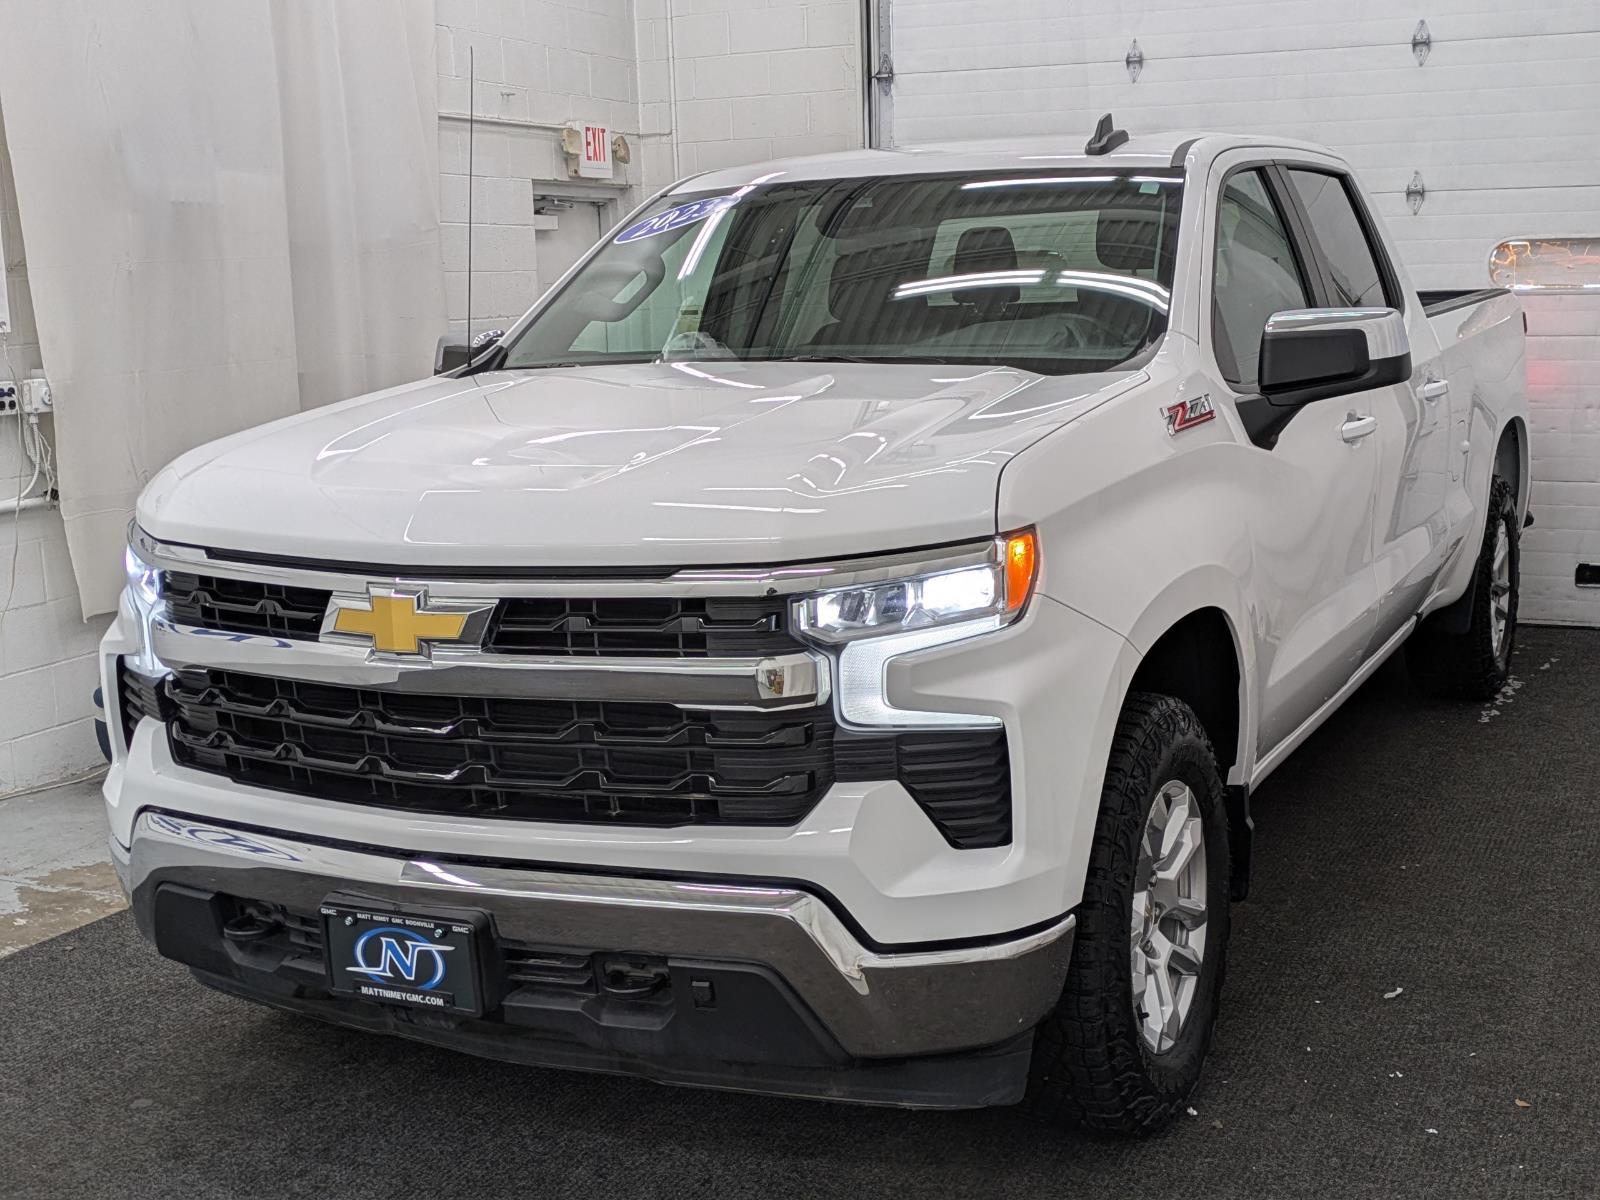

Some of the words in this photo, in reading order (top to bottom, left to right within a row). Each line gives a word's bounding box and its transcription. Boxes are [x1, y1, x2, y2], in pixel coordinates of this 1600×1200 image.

[585, 127, 606, 162] EXIT
[1160, 393, 1216, 436] Z71
[320, 908, 337, 916] GMC
[405, 919, 435, 929] BOONVILLE
[452, 926, 469, 934] GMC
[361, 986, 444, 1006] MATTNIMEYGMC.COM
